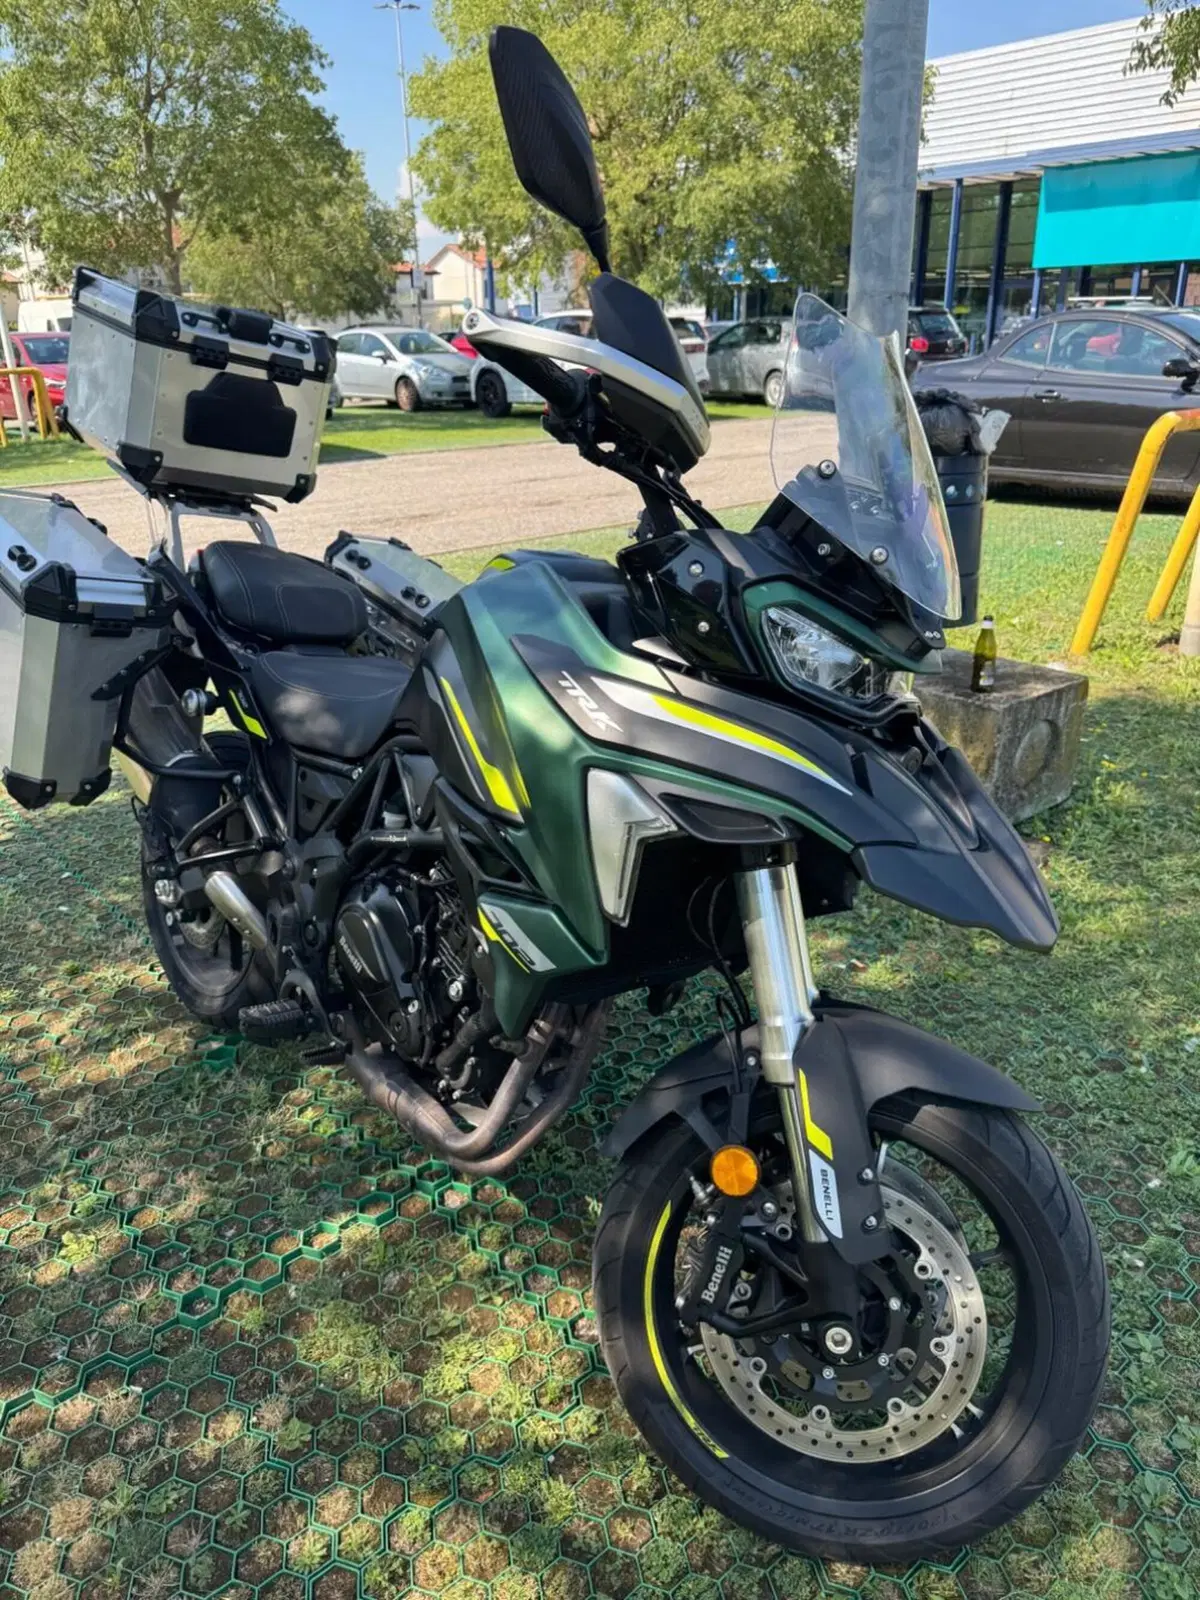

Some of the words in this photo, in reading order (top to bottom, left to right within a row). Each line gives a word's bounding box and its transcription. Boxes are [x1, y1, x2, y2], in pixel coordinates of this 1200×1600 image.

[558, 670, 624, 732] TRK
[820, 1168, 834, 1221] BENELLI
[701, 1245, 733, 1304] Benelli
